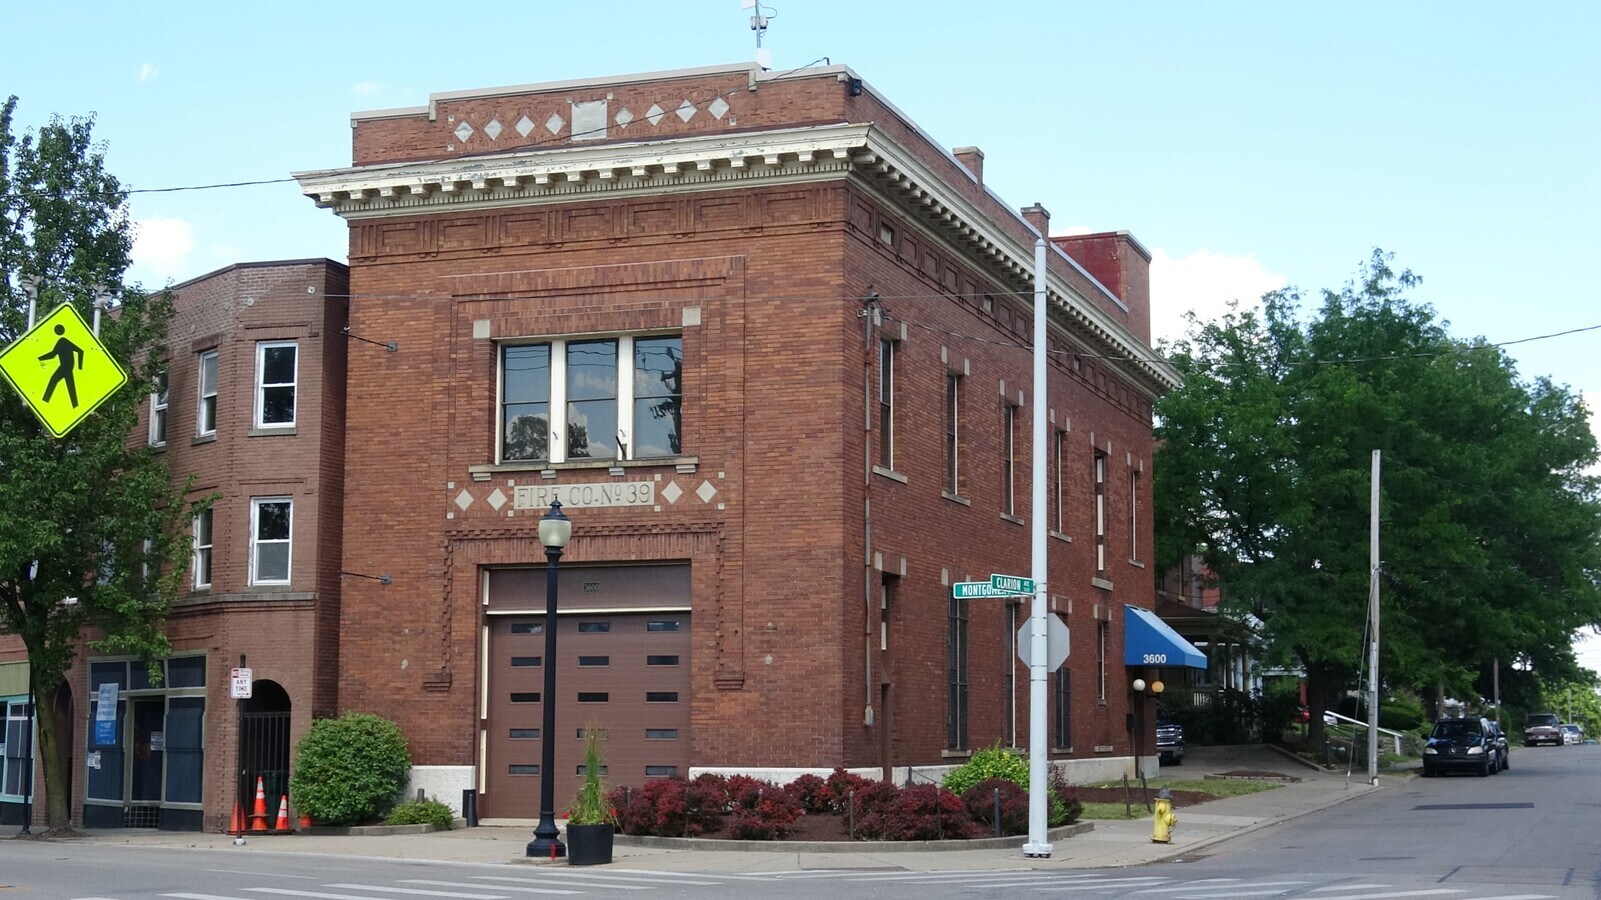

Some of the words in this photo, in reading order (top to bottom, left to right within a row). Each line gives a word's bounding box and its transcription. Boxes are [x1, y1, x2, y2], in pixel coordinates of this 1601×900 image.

[625, 483, 651, 504] 39
[962, 584, 1010, 596] MONTGO
[996, 577, 1021, 591] CLARION
[1143, 654, 1167, 664] 3600
